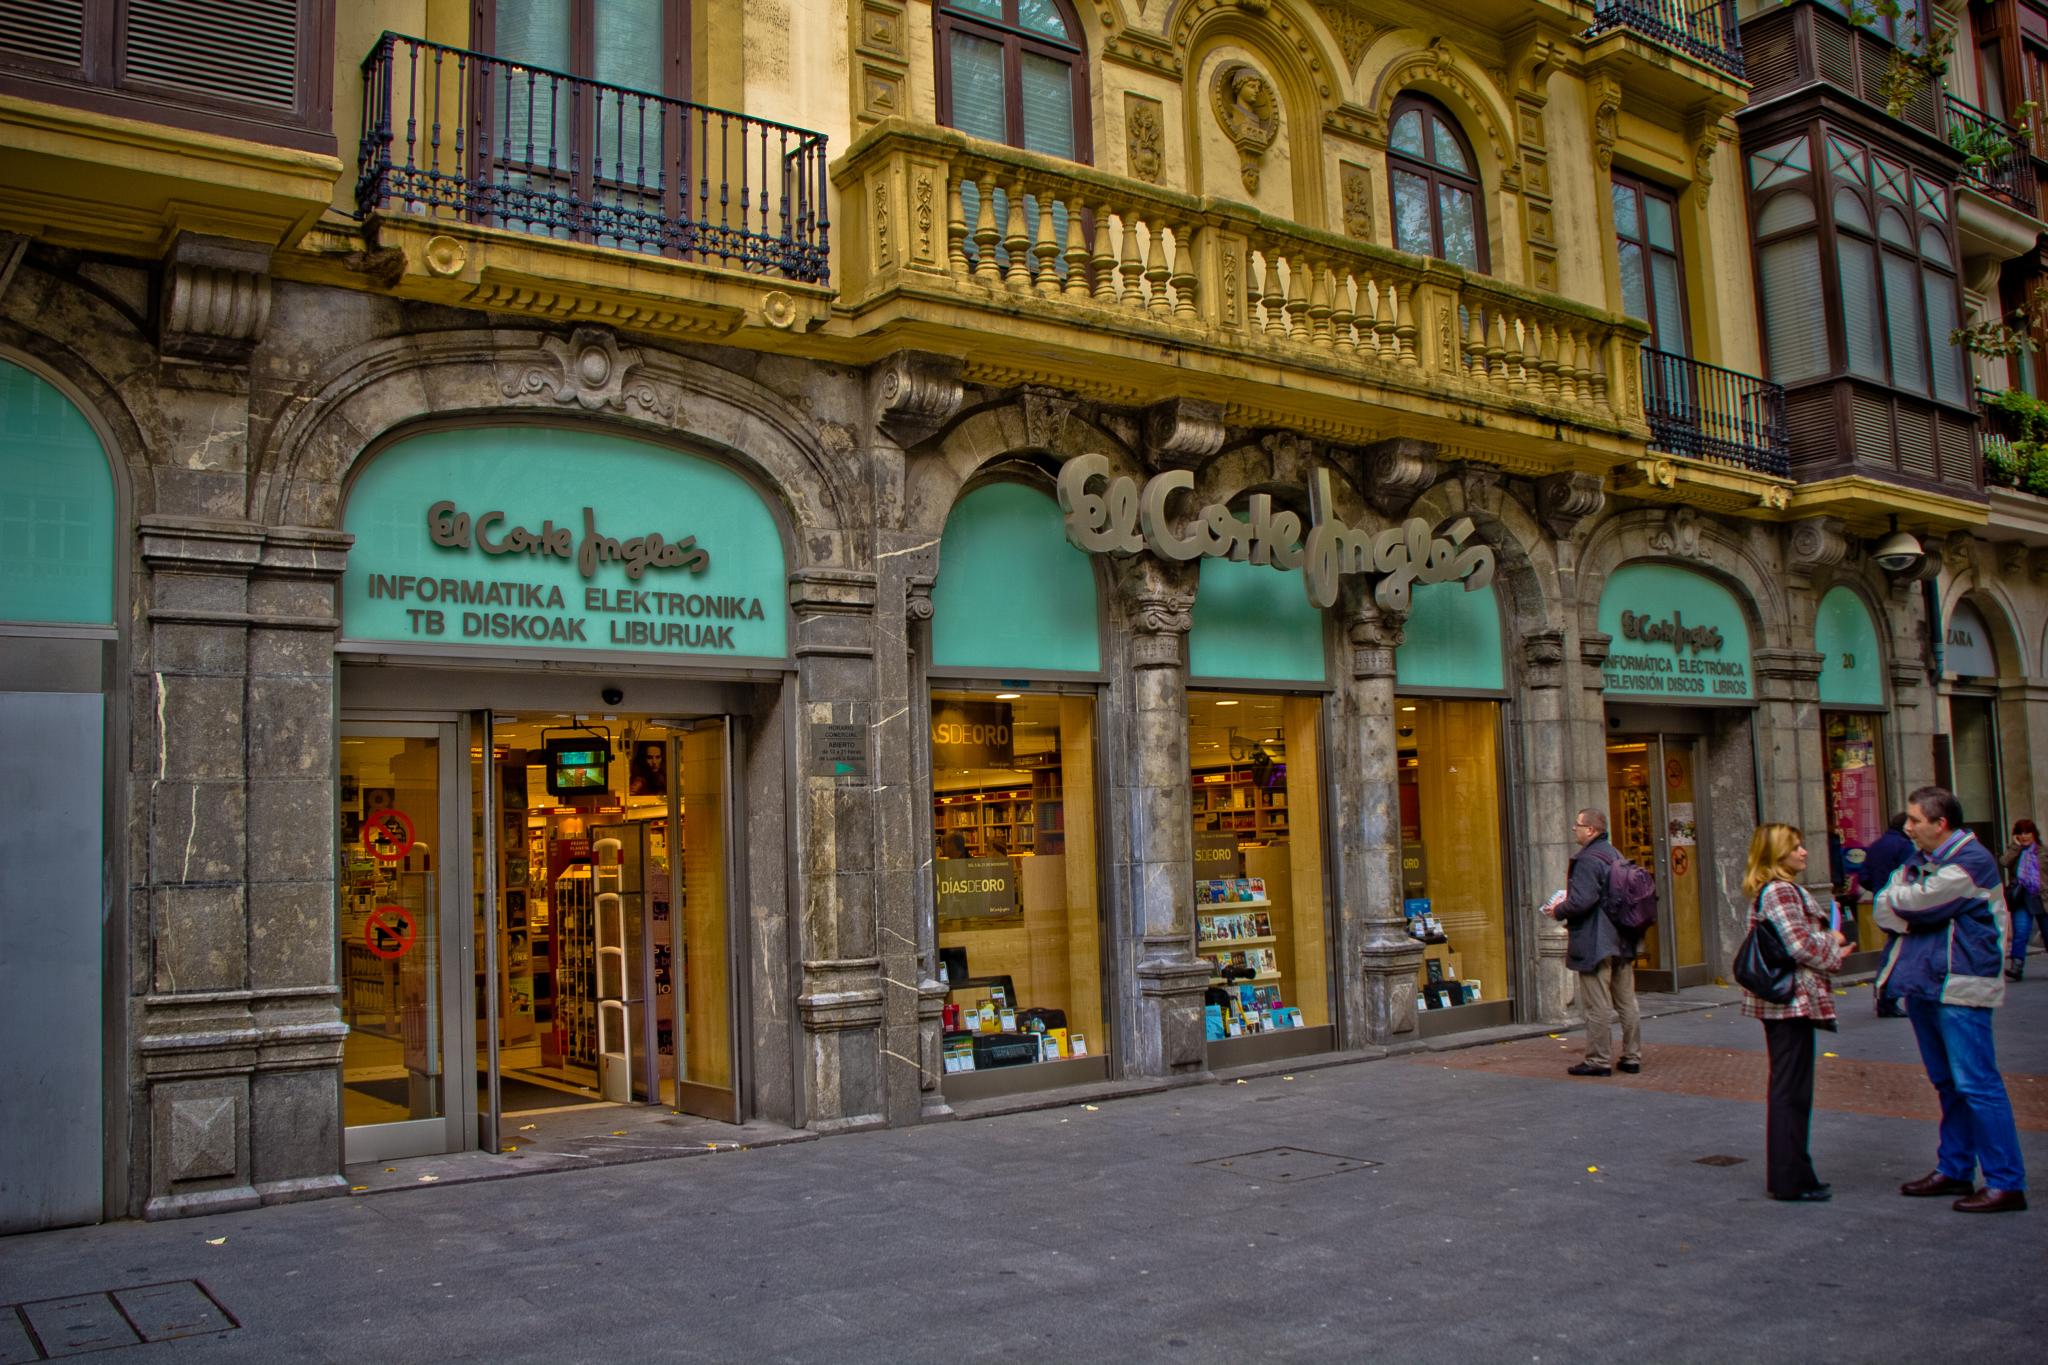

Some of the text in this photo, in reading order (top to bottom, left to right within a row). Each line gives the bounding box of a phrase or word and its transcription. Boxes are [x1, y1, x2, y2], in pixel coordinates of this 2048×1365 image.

[428, 500, 471, 549] El
[475, 511, 573, 559] Corte
[1057, 453, 1145, 557] El
[1142, 469, 1304, 571] Corte
[368, 574, 765, 621] INFORMATIKA ELEKTRONIKA
[406, 608, 736, 649] TB DISKOAK LIBURUAK
[1603, 654, 1745, 676] INFORMÁTICA ELECTRÓNICA
[1603, 672, 1747, 695] TELEVISIÓN DISCOS LIBROS
